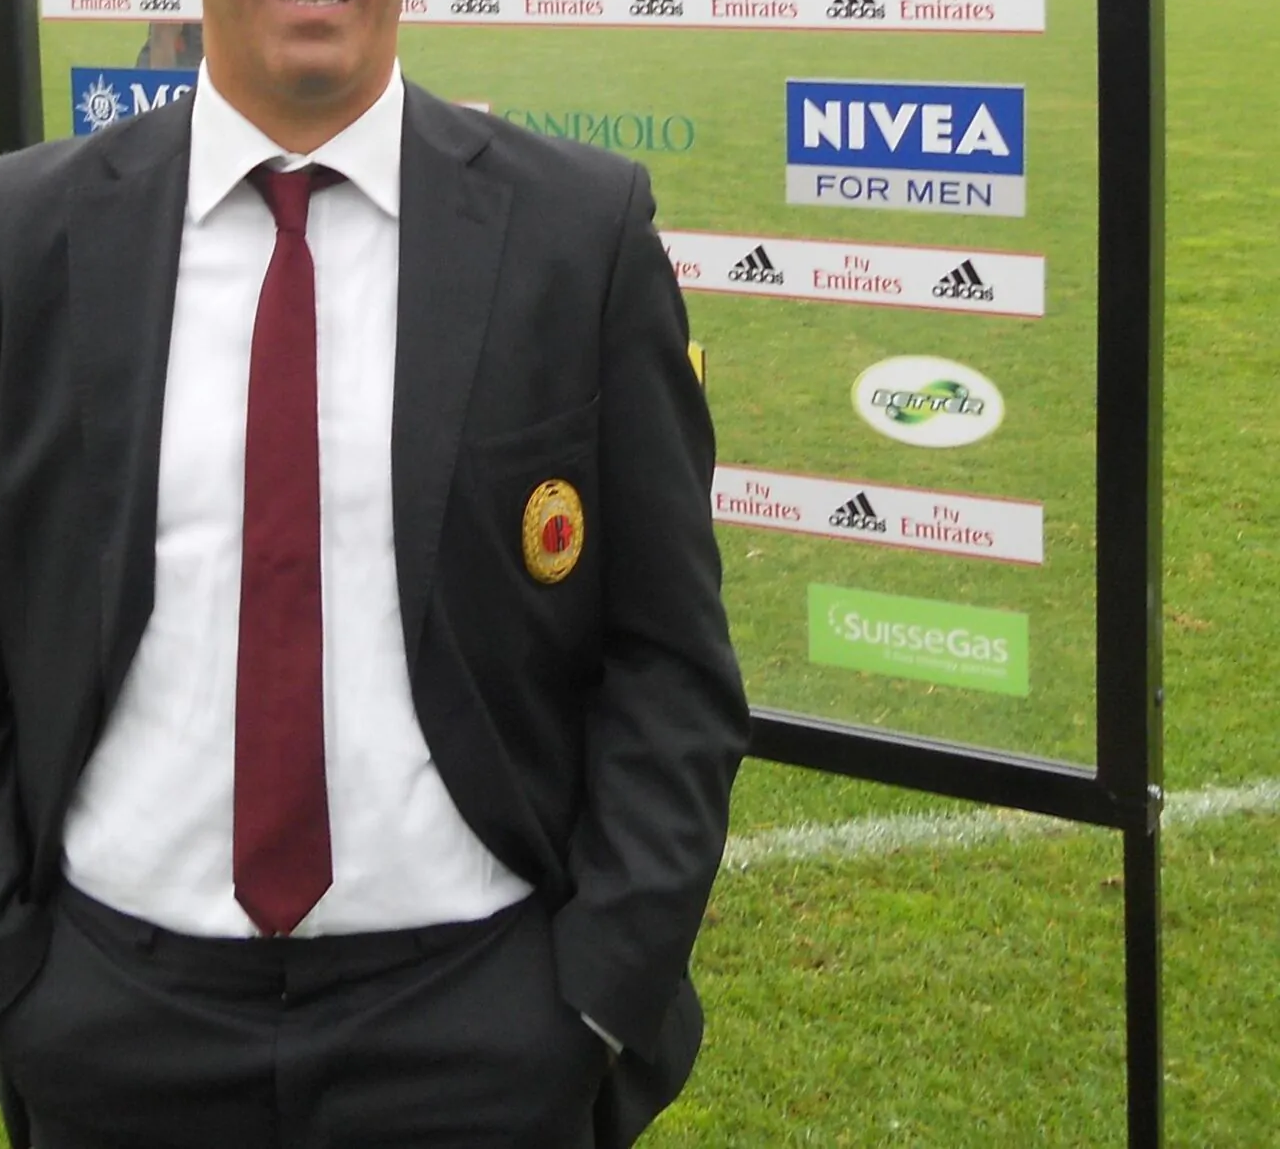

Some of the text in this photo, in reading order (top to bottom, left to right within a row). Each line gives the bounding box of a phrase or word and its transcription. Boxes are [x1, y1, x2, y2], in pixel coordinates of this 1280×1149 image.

[450, 0, 499, 13] adidas
[826, 2, 885, 19] adidas
[804, 97, 1009, 156] NIVEA
[817, 175, 992, 206] FOR MEN
[845, 255, 870, 273] Fly
[728, 267, 784, 286] adidas
[813, 269, 902, 294] Emirates
[932, 283, 994, 302] adidas
[746, 482, 770, 499] Fly
[716, 493, 801, 521] Emirates
[933, 505, 960, 523] Fly
[829, 513, 887, 534] adidas
[901, 516, 995, 547] Emirates
